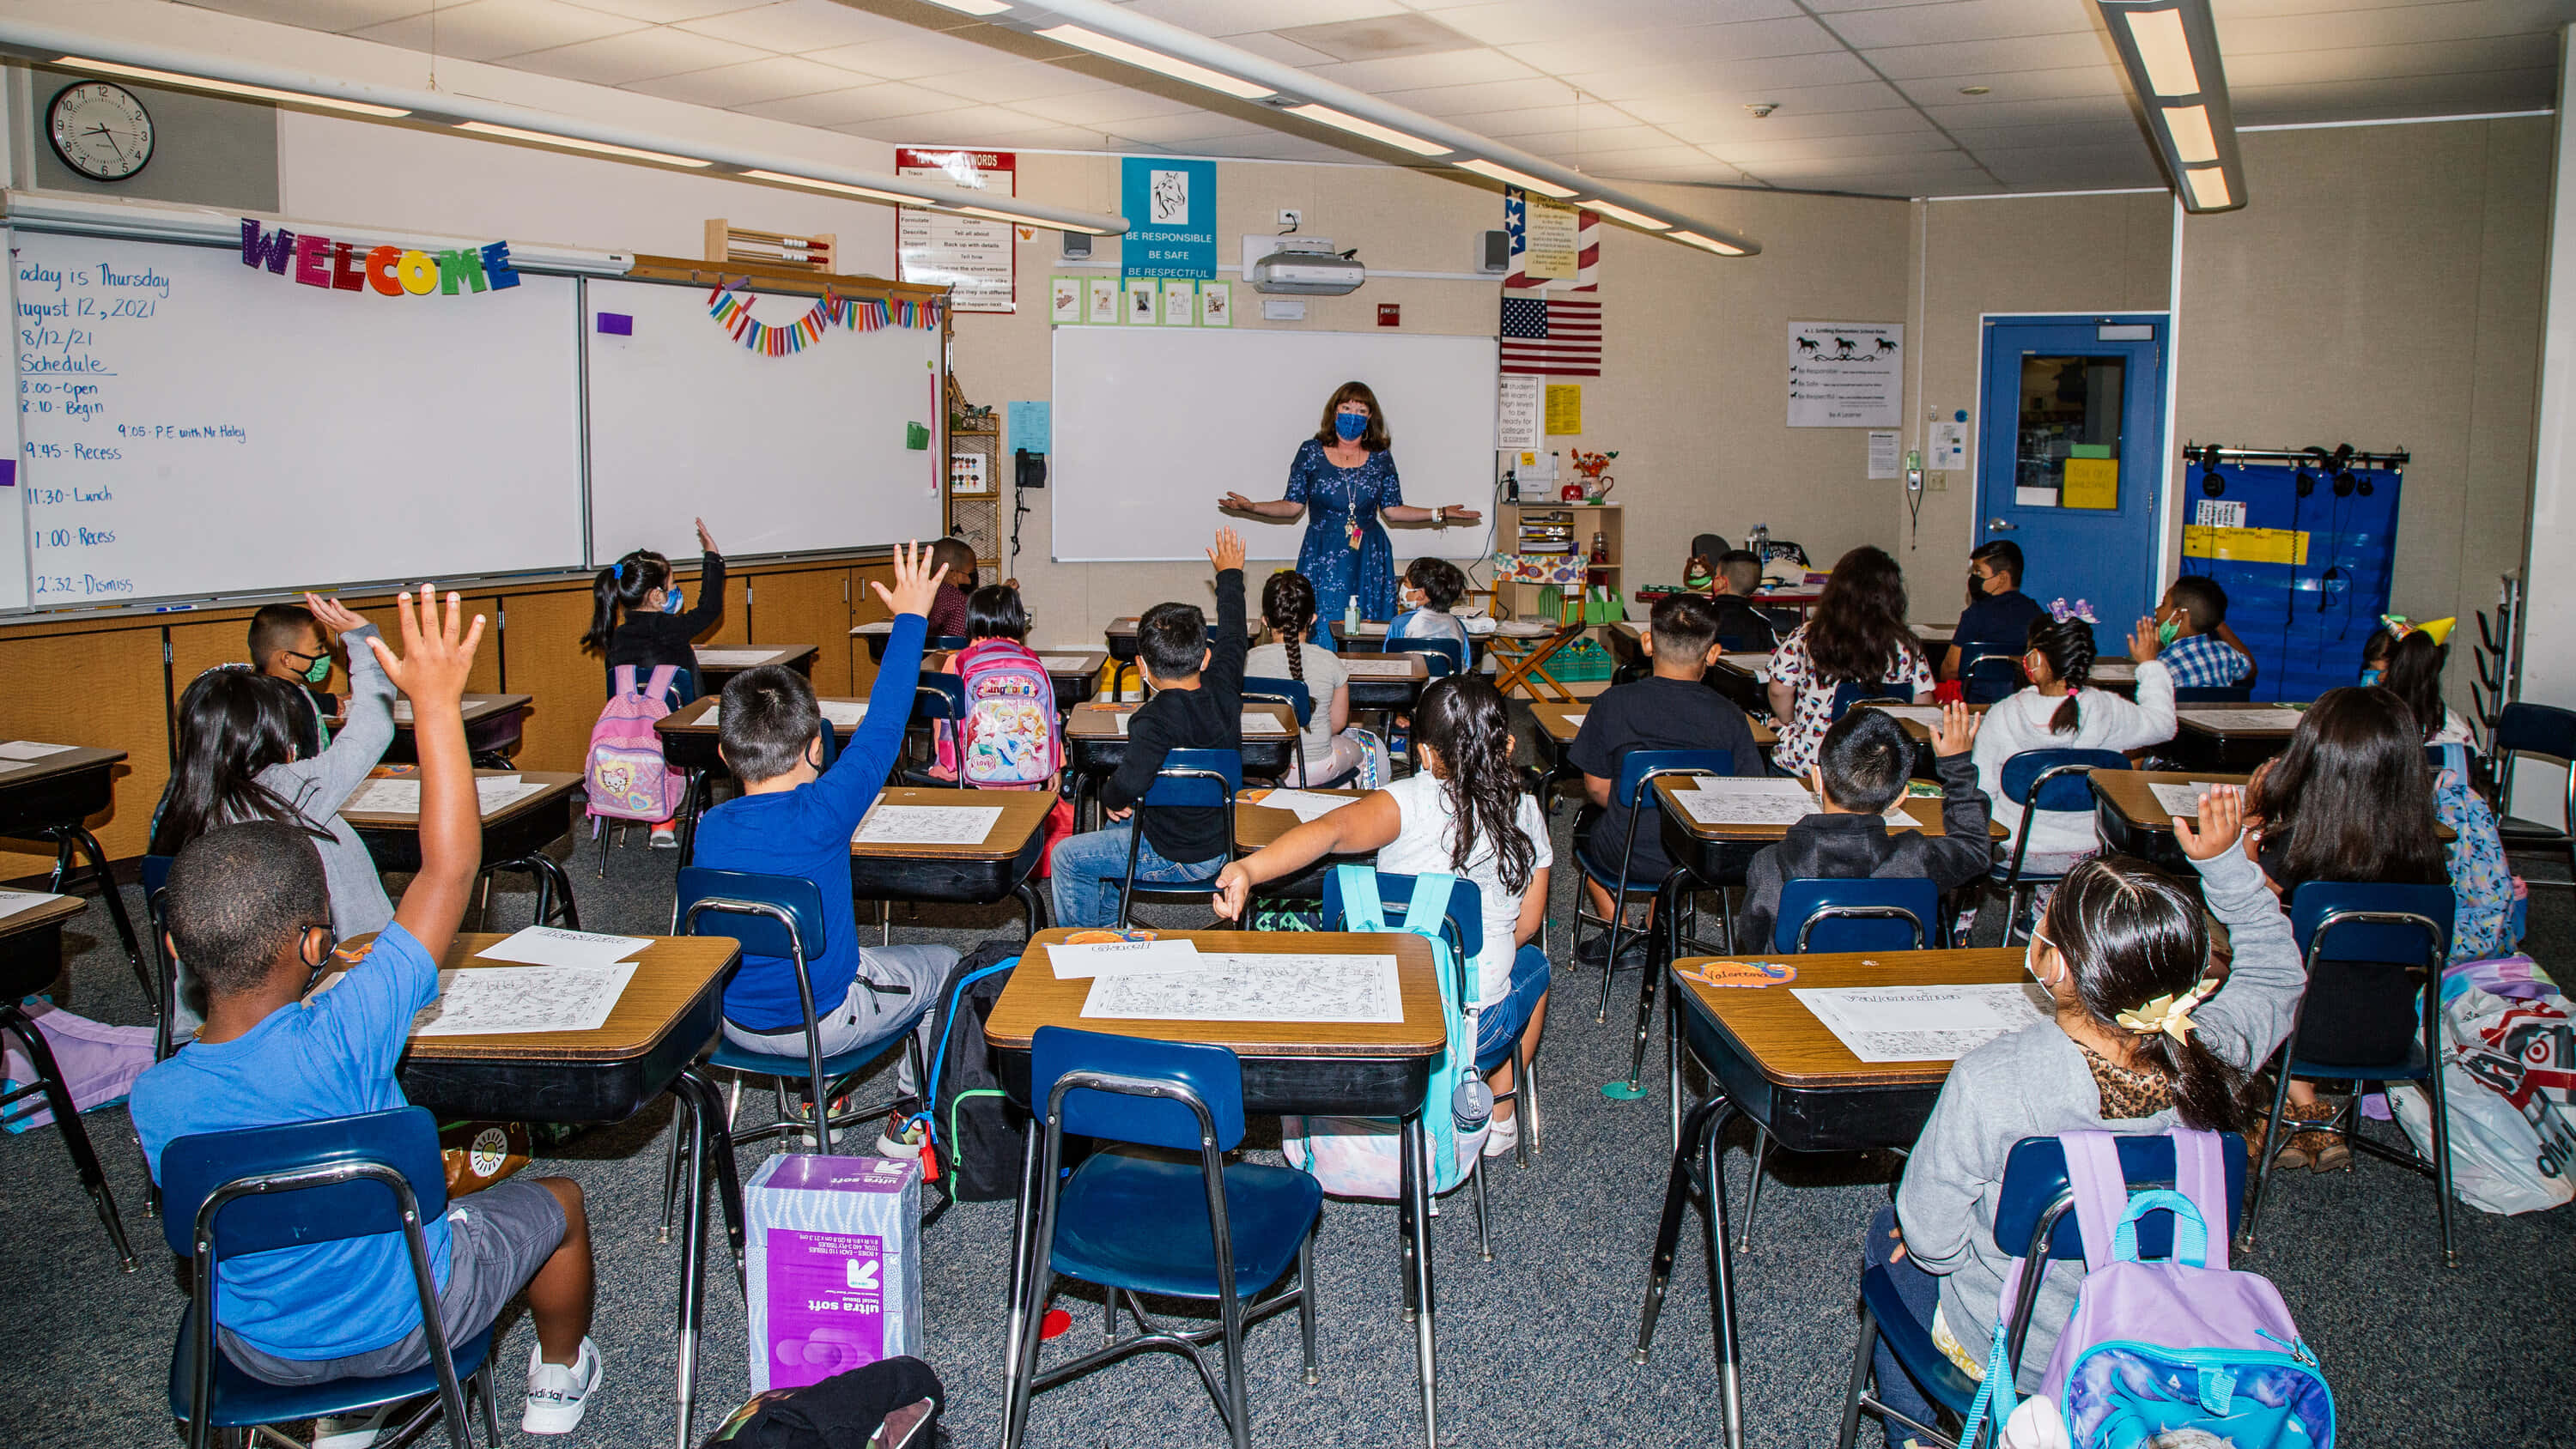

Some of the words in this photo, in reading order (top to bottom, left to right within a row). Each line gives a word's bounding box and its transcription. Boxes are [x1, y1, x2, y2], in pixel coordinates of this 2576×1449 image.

[76, 89, 85, 99] 11
[98, 87, 108, 97] 12
[121, 95, 125, 104] 1
[62, 100, 72, 111] 10
[136, 111, 142, 120] 2
[57, 120, 64, 130] 9
[141, 131, 148, 142] 3
[64, 142, 72, 152] 8
[134, 151, 142, 161] 4
[79, 157, 86, 166] 7
[102, 166, 109, 176] 6
[122, 163, 129, 173] 5
[1126, 232, 1139, 240] BE
[1142, 233, 1212, 243] RESPONSIBLE
[241, 217, 520, 296] WELCOME
[1164, 251, 1188, 259] SAFE
[1145, 268, 1209, 278] RESPECTFUL
[70, 268, 88, 286] is
[96, 263, 170, 298] Thursday
[111, 299, 156, 318] 2021
[21, 328, 92, 354] 8/12/21
[21, 354, 107, 373] Schedule
[179, 427, 201, 439] with
[220, 425, 246, 444] Haley
[2536, 1131, 2574, 1179] drive
[807, 1300, 839, 1312] soft
[842, 1301, 879, 1315] ultra
